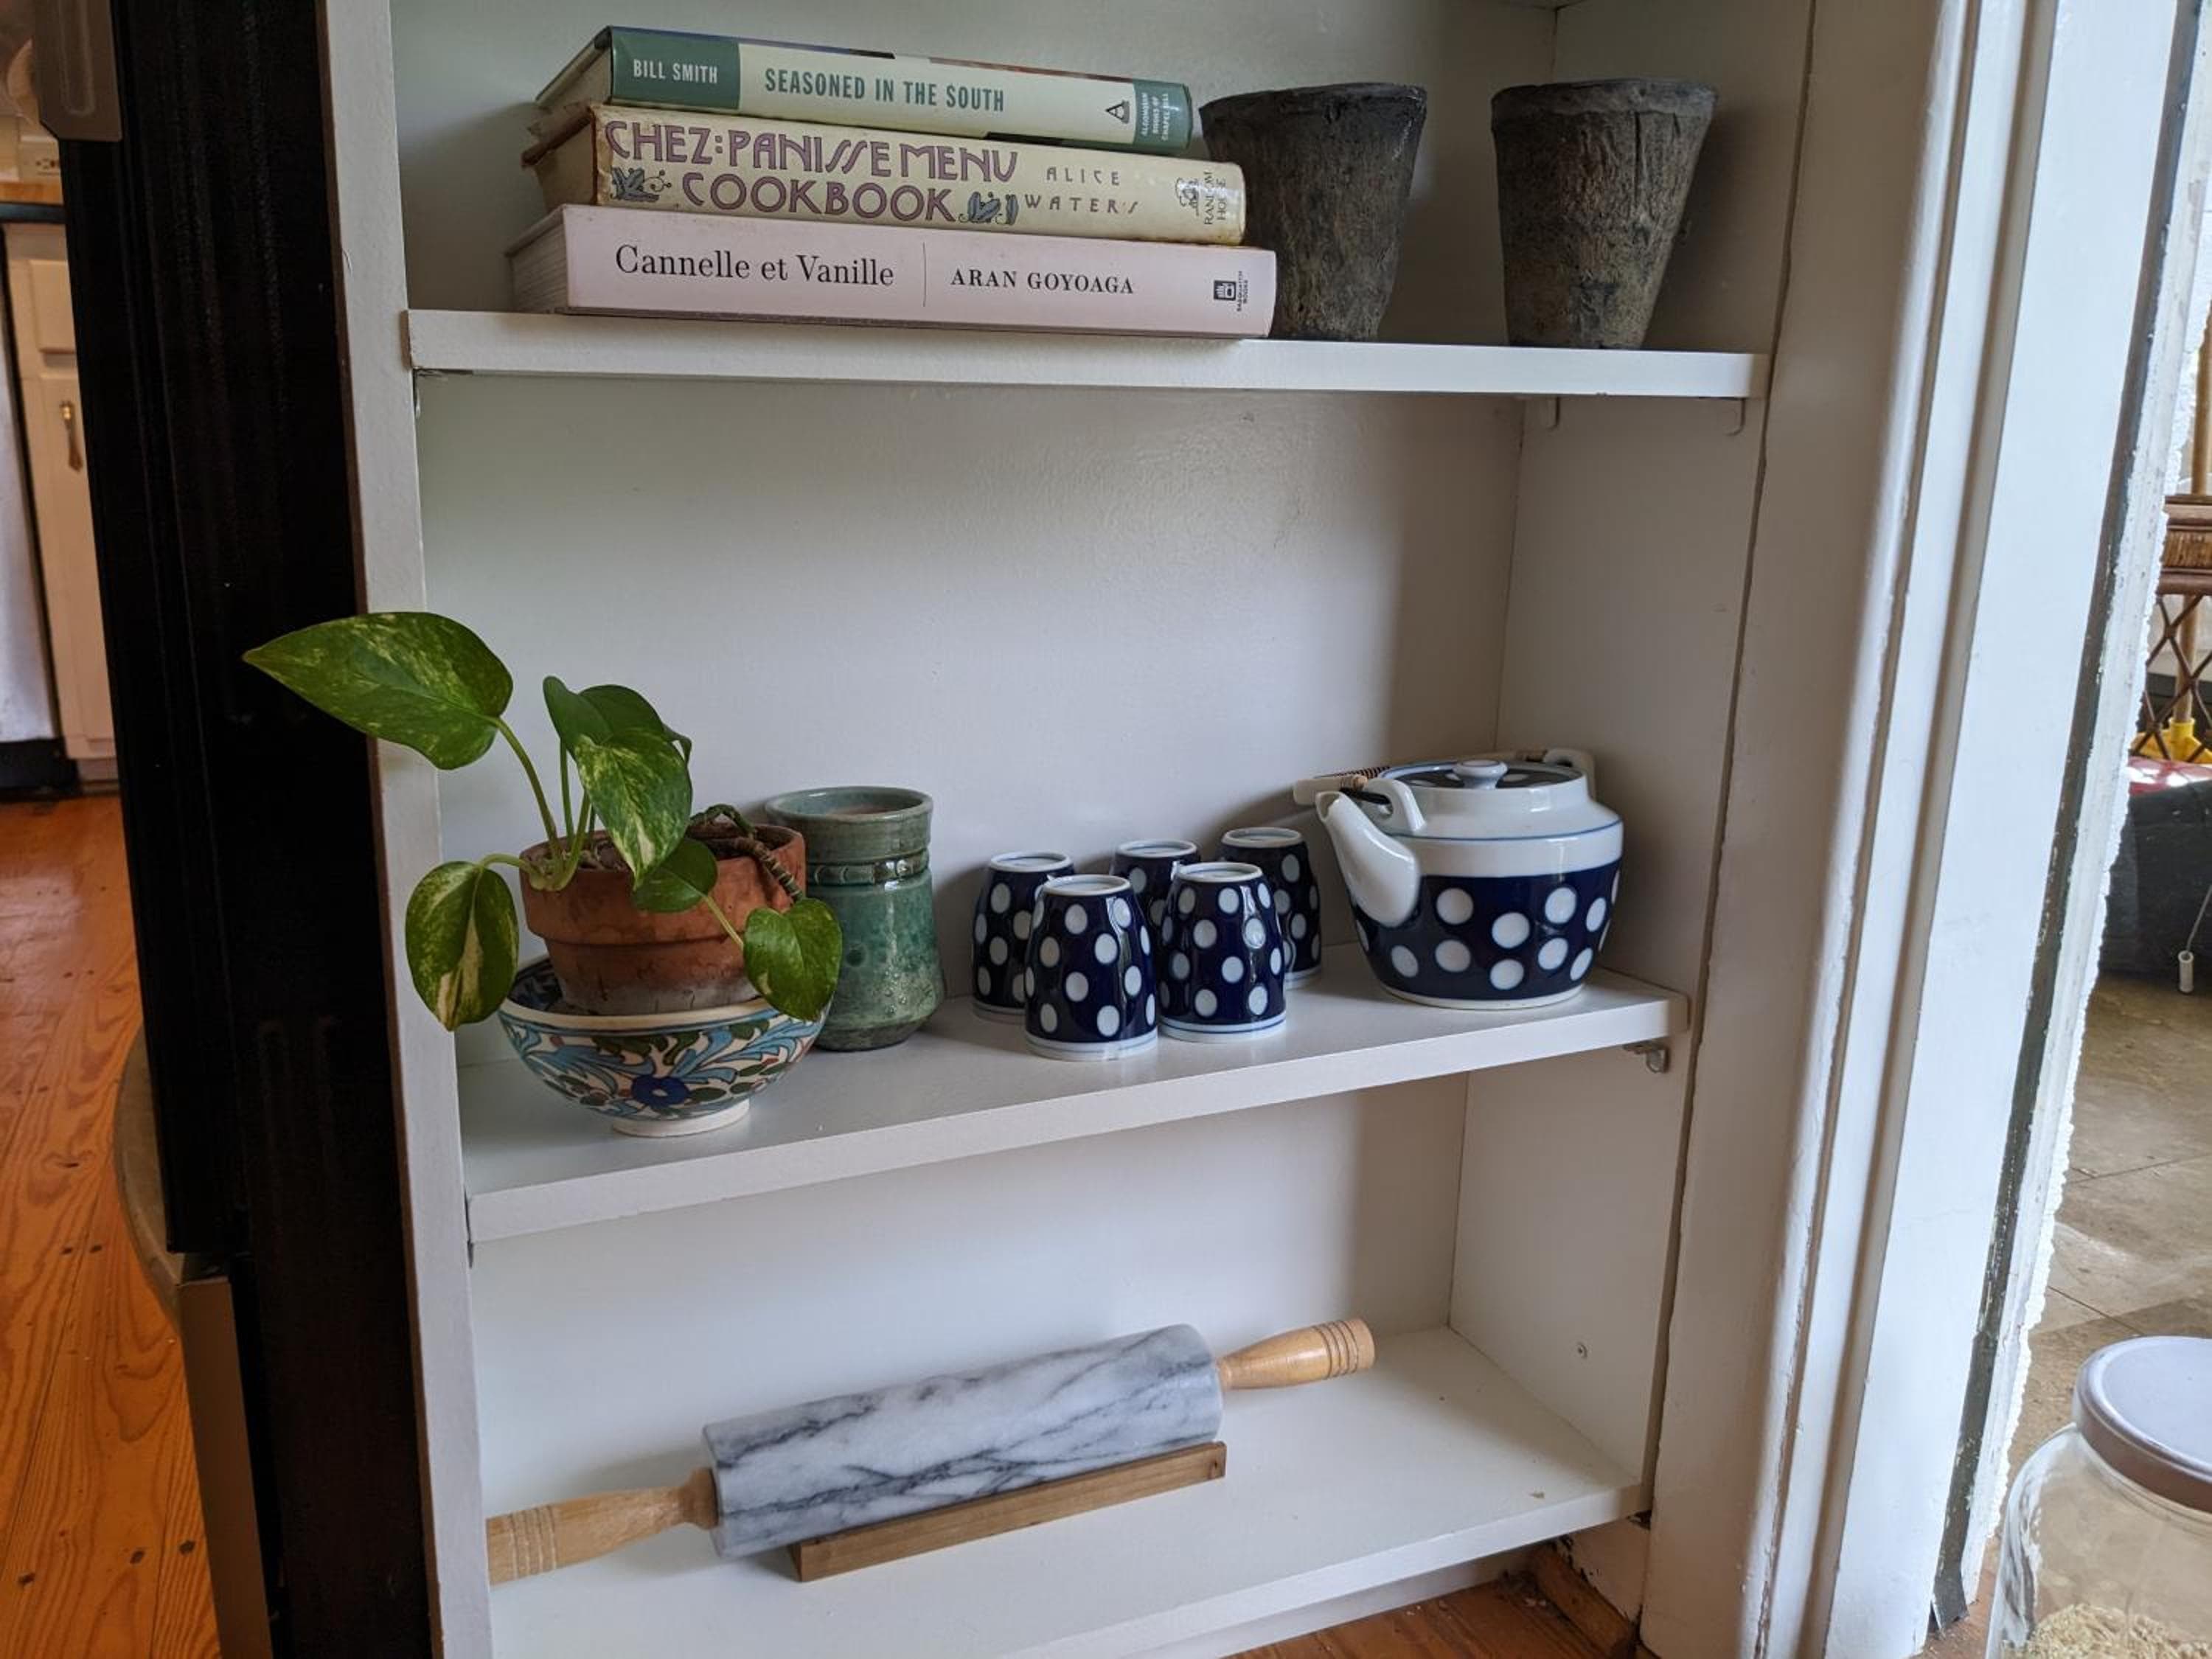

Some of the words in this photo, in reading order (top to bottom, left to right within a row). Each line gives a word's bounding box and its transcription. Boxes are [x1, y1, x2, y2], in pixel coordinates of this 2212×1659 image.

[633, 58, 666, 78] BILL
[672, 63, 718, 84] SMITH
[765, 68, 866, 100] SEASONED
[875, 78, 894, 102] IN
[902, 81, 937, 106] THE
[946, 84, 1004, 112] SOUTH
[899, 142, 1018, 183] MENU
[1046, 167, 1120, 187] ALICE
[682, 172, 956, 222] COOKBOOK
[615, 243, 751, 279] Cannelle
[761, 260, 787, 281] et
[796, 254, 894, 286] Vanille
[951, 268, 1017, 288] ARAN
[1027, 271, 1134, 295] GOYOAGA
